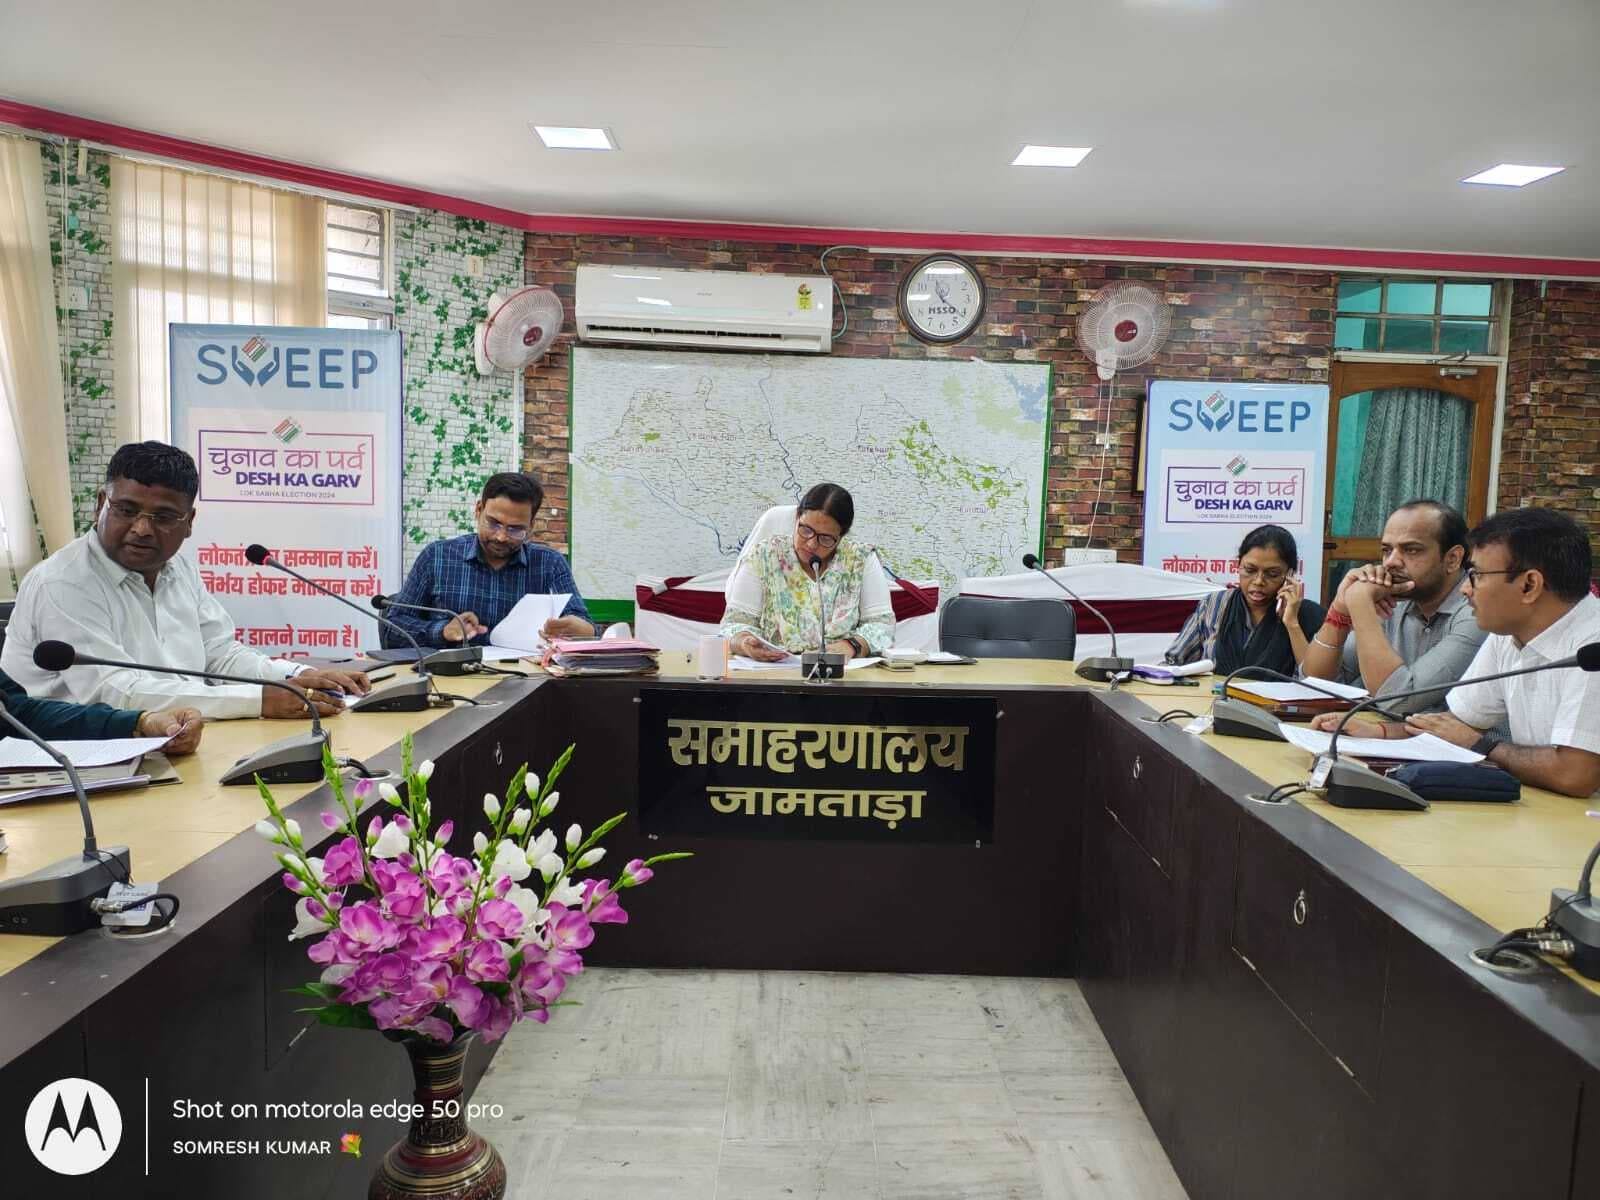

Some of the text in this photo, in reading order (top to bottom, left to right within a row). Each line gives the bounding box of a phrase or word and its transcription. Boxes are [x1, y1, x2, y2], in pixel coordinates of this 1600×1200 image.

[197, 343, 378, 390] SWEEP
[1168, 398, 1311, 433] SWEEP
[208, 443, 366, 475] चुनाव का पर्व
[235, 471, 362, 488] DESH KA GARV
[1174, 475, 1299, 503] चुनाव का पर्व
[1194, 499, 1294, 511] DESH KA GARV
[283, 549, 343, 569] सम्मान
[1211, 559, 1226, 574] का
[247, 572, 289, 596] होकर
[248, 623, 294, 646] डालने
[297, 629, 338, 647] जाना
[667, 718, 970, 774] समाहरणालय
[706, 785, 928, 830] जामताड़ा
